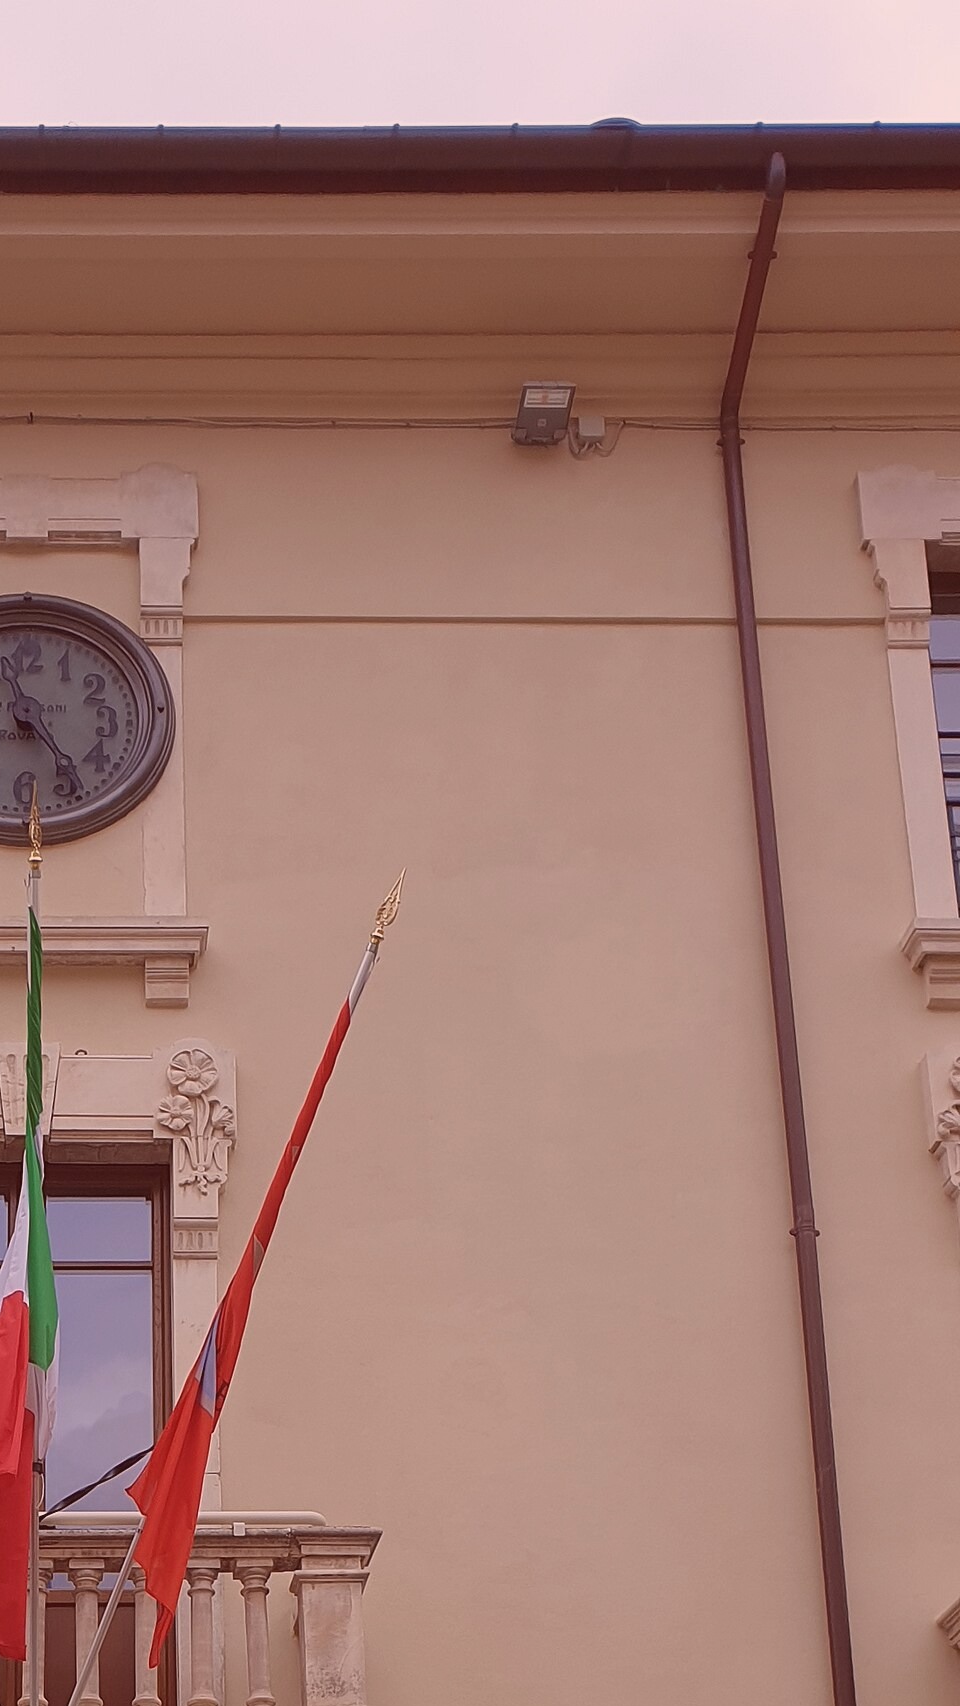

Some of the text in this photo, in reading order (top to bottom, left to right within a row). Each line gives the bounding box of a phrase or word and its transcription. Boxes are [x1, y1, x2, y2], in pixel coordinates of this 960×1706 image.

[11, 639, 43, 673] 12
[57, 649, 71, 682] 1
[83, 673, 106, 704] 2
[95, 705, 119, 738] 3
[82, 738, 111, 773] 4
[13, 771, 36, 804] 6
[53, 765, 77, 797] 5
